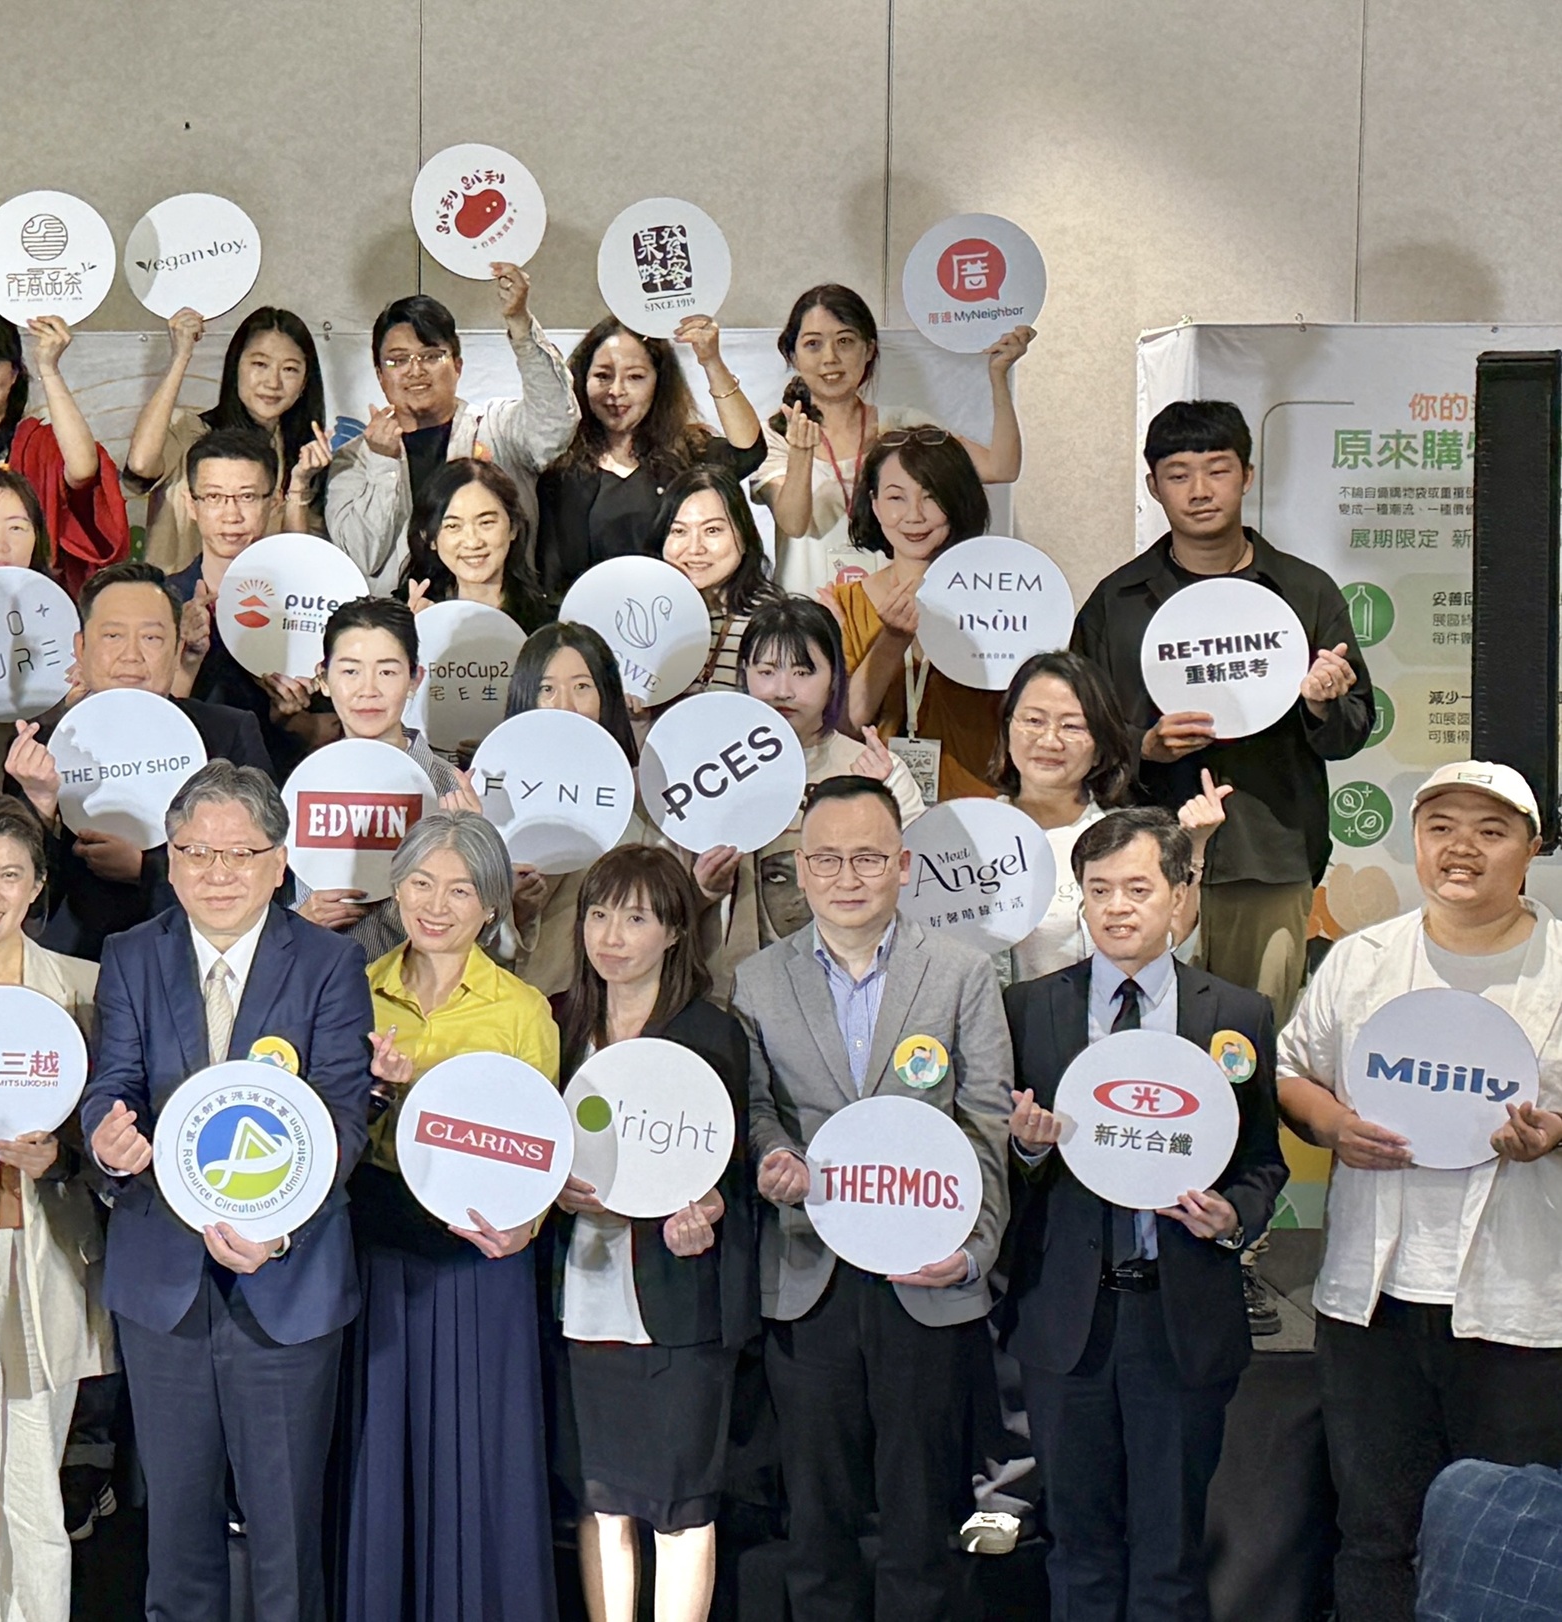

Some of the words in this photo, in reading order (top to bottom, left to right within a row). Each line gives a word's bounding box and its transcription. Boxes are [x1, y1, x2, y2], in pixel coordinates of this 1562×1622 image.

[135, 249, 204, 273] Vegan
[644, 301, 675, 312] SINCE
[954, 305, 1025, 322] MyNeighbor
[1409, 393, 1476, 422] 你的
[1331, 429, 1476, 471] 原來購
[1350, 529, 1439, 549] 展期限定
[947, 571, 1043, 592] ANEM
[1184, 657, 1270, 684] 重新思考
[61, 767, 94, 784] THE
[99, 760, 142, 780] BODY
[147, 755, 190, 775] SHOP
[484, 776, 617, 807] FYNE
[307, 803, 408, 839] EDWIN
[914, 835, 1028, 898] Angel
[1366, 1052, 1520, 1103] Mijily
[1130, 1086, 1160, 1112] 光
[425, 1120, 544, 1162] CLARINS
[1094, 1123, 1192, 1156] 新光合纖
